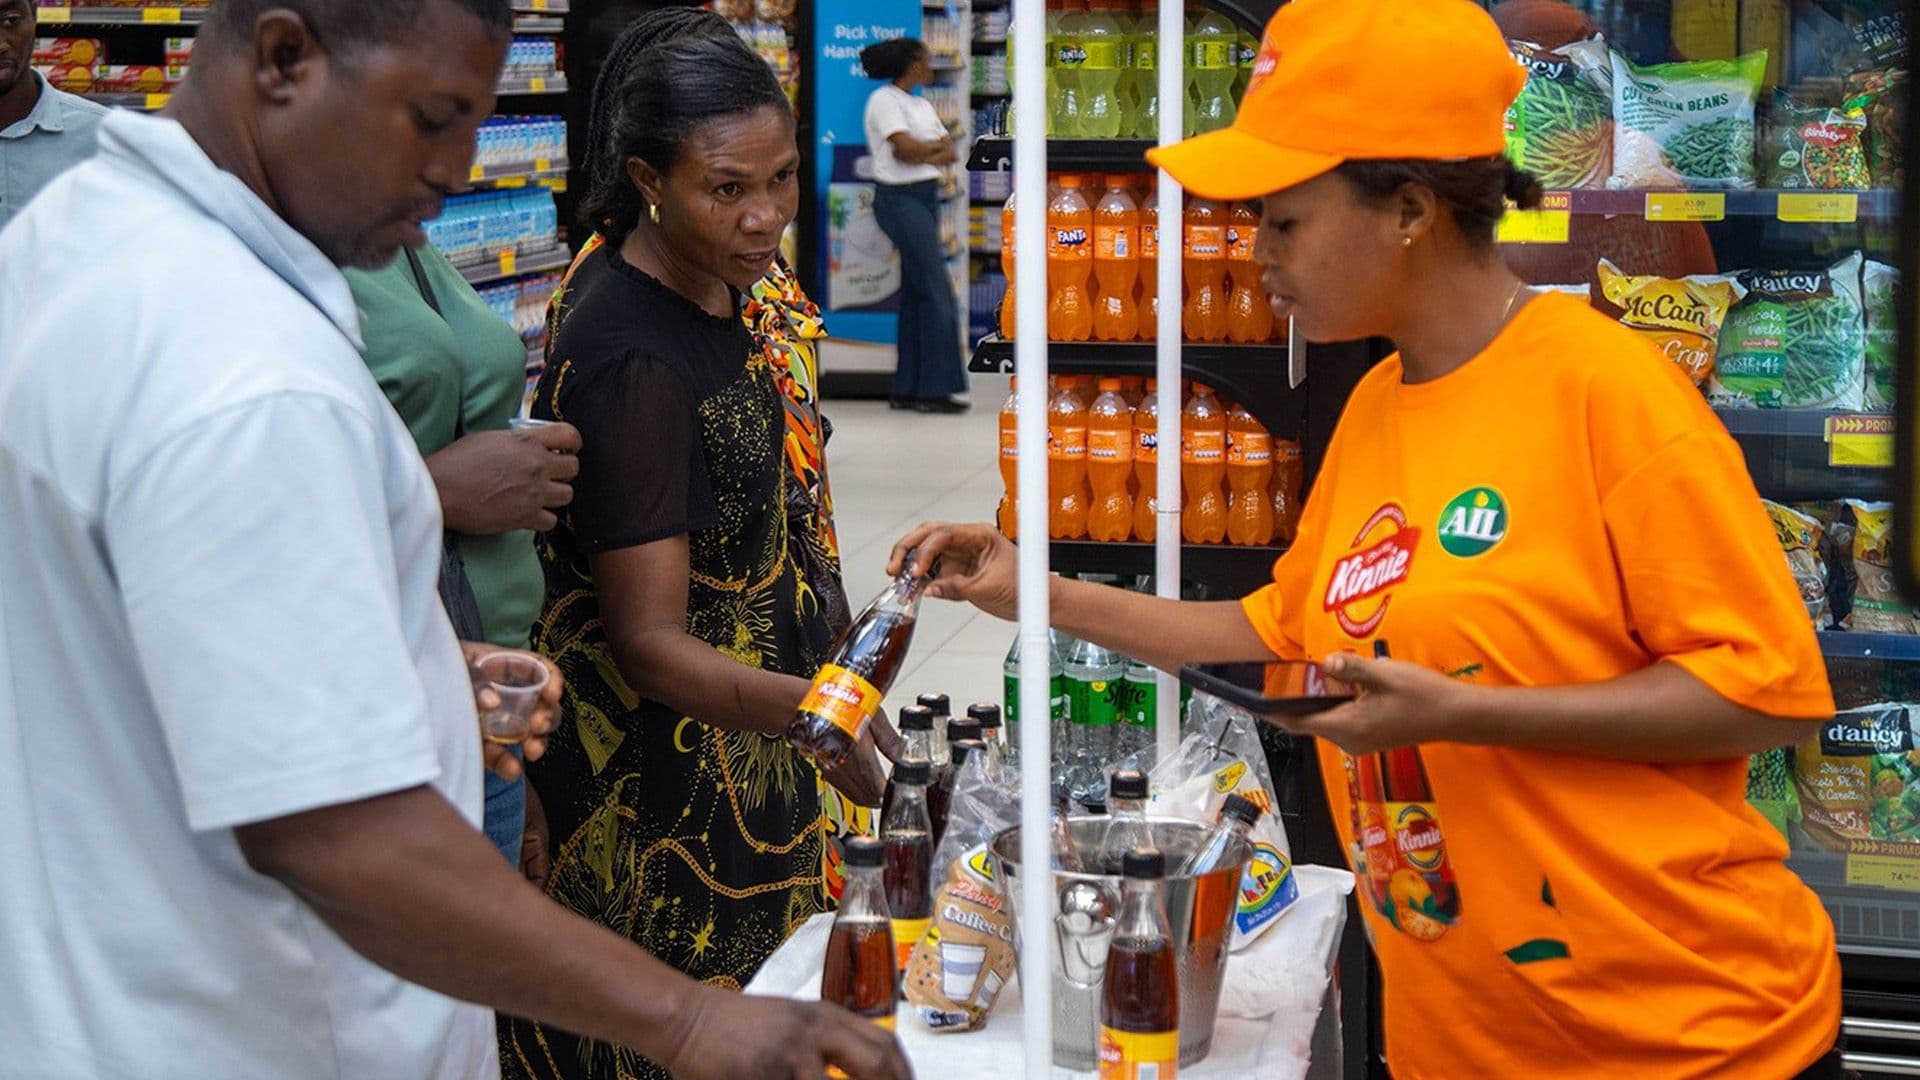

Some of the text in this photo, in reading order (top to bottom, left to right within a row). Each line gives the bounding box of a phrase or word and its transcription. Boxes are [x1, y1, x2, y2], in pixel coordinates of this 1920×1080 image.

[835, 24, 906, 39] Pick Your
[1687, 92, 1729, 112] BEANS
[1543, 195, 1568, 208] OMO
[1624, 294, 1706, 327] McCain
[1439, 506, 1504, 542] AIL
[1327, 547, 1409, 606] Kinnie
[1828, 723, 1904, 747] d'aucy
[1398, 825, 1442, 852] Kinnie
[943, 903, 997, 935] Coffee
